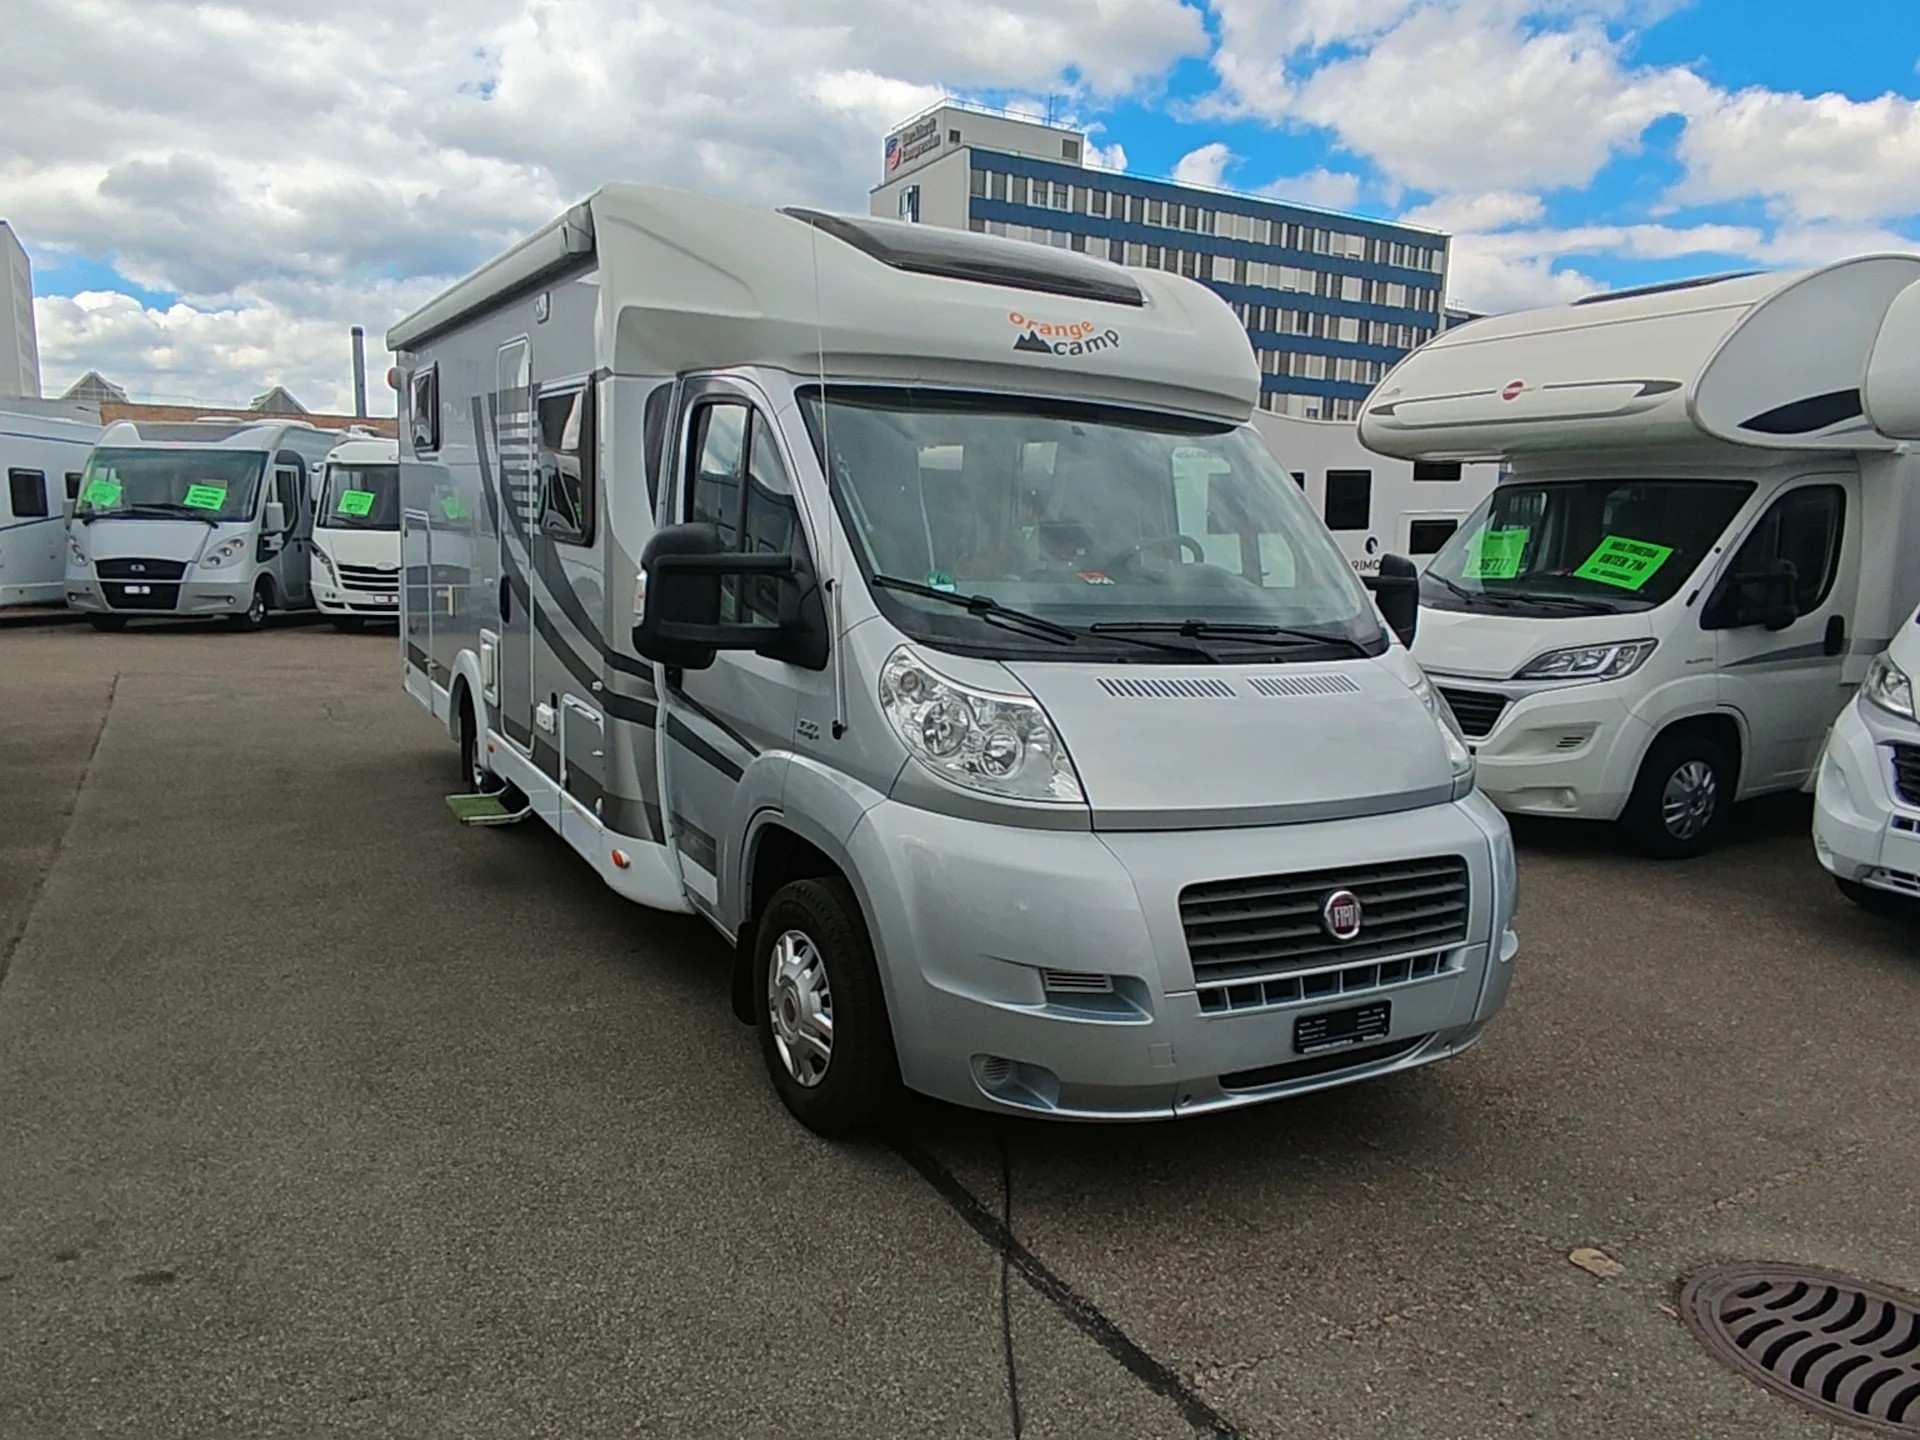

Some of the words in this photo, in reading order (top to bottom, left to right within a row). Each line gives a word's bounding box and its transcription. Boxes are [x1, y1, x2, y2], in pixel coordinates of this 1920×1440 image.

[1008, 311, 1095, 340] orange
[1053, 328, 1119, 356] camp
[1351, 559, 1381, 571] RIMO
[1333, 904, 1355, 928] FIAT
